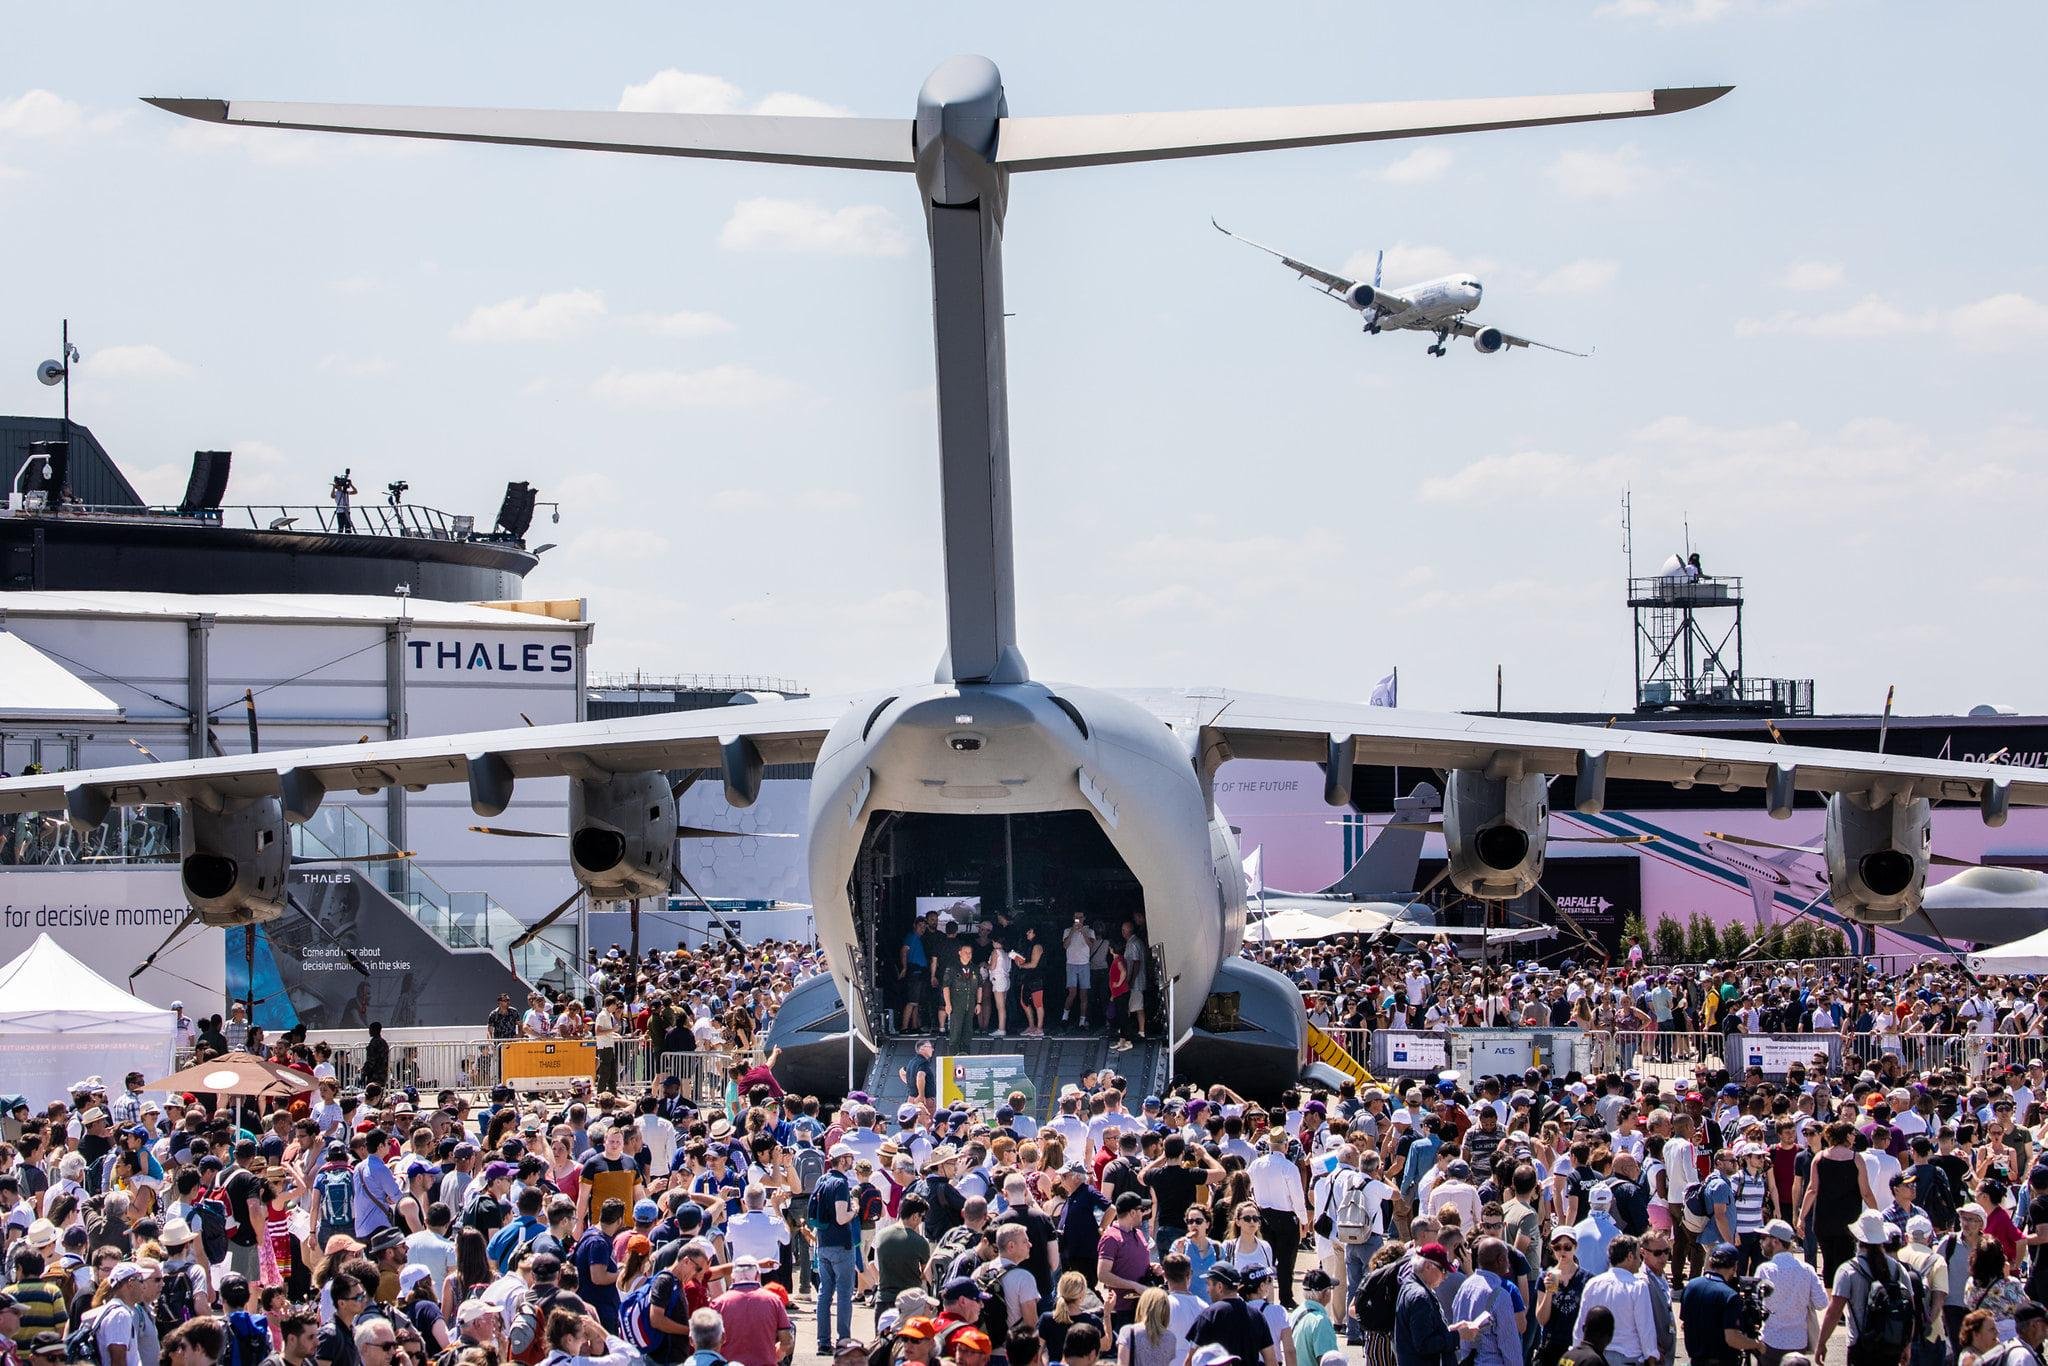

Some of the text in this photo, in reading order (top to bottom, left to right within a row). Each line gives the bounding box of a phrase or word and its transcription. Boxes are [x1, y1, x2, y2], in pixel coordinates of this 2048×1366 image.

[407, 641, 572, 673] THALES
[1221, 782, 1235, 792] OF
[1238, 781, 1258, 792] THE
[1259, 780, 1299, 792] FUTURE
[302, 874, 351, 883] THALES
[1556, 896, 1598, 907] RAFALE
[5, 905, 31, 927] for
[36, 905, 110, 927] decisive
[302, 947, 324, 957] Come
[326, 946, 340, 957] and
[359, 946, 381, 957] about
[302, 961, 333, 971] decisive
[370, 960, 378, 970] in
[378, 960, 391, 970] the
[392, 960, 411, 970] skies
[1494, 1047, 1516, 1055] AES
[539, 1060, 562, 1069] THALES
